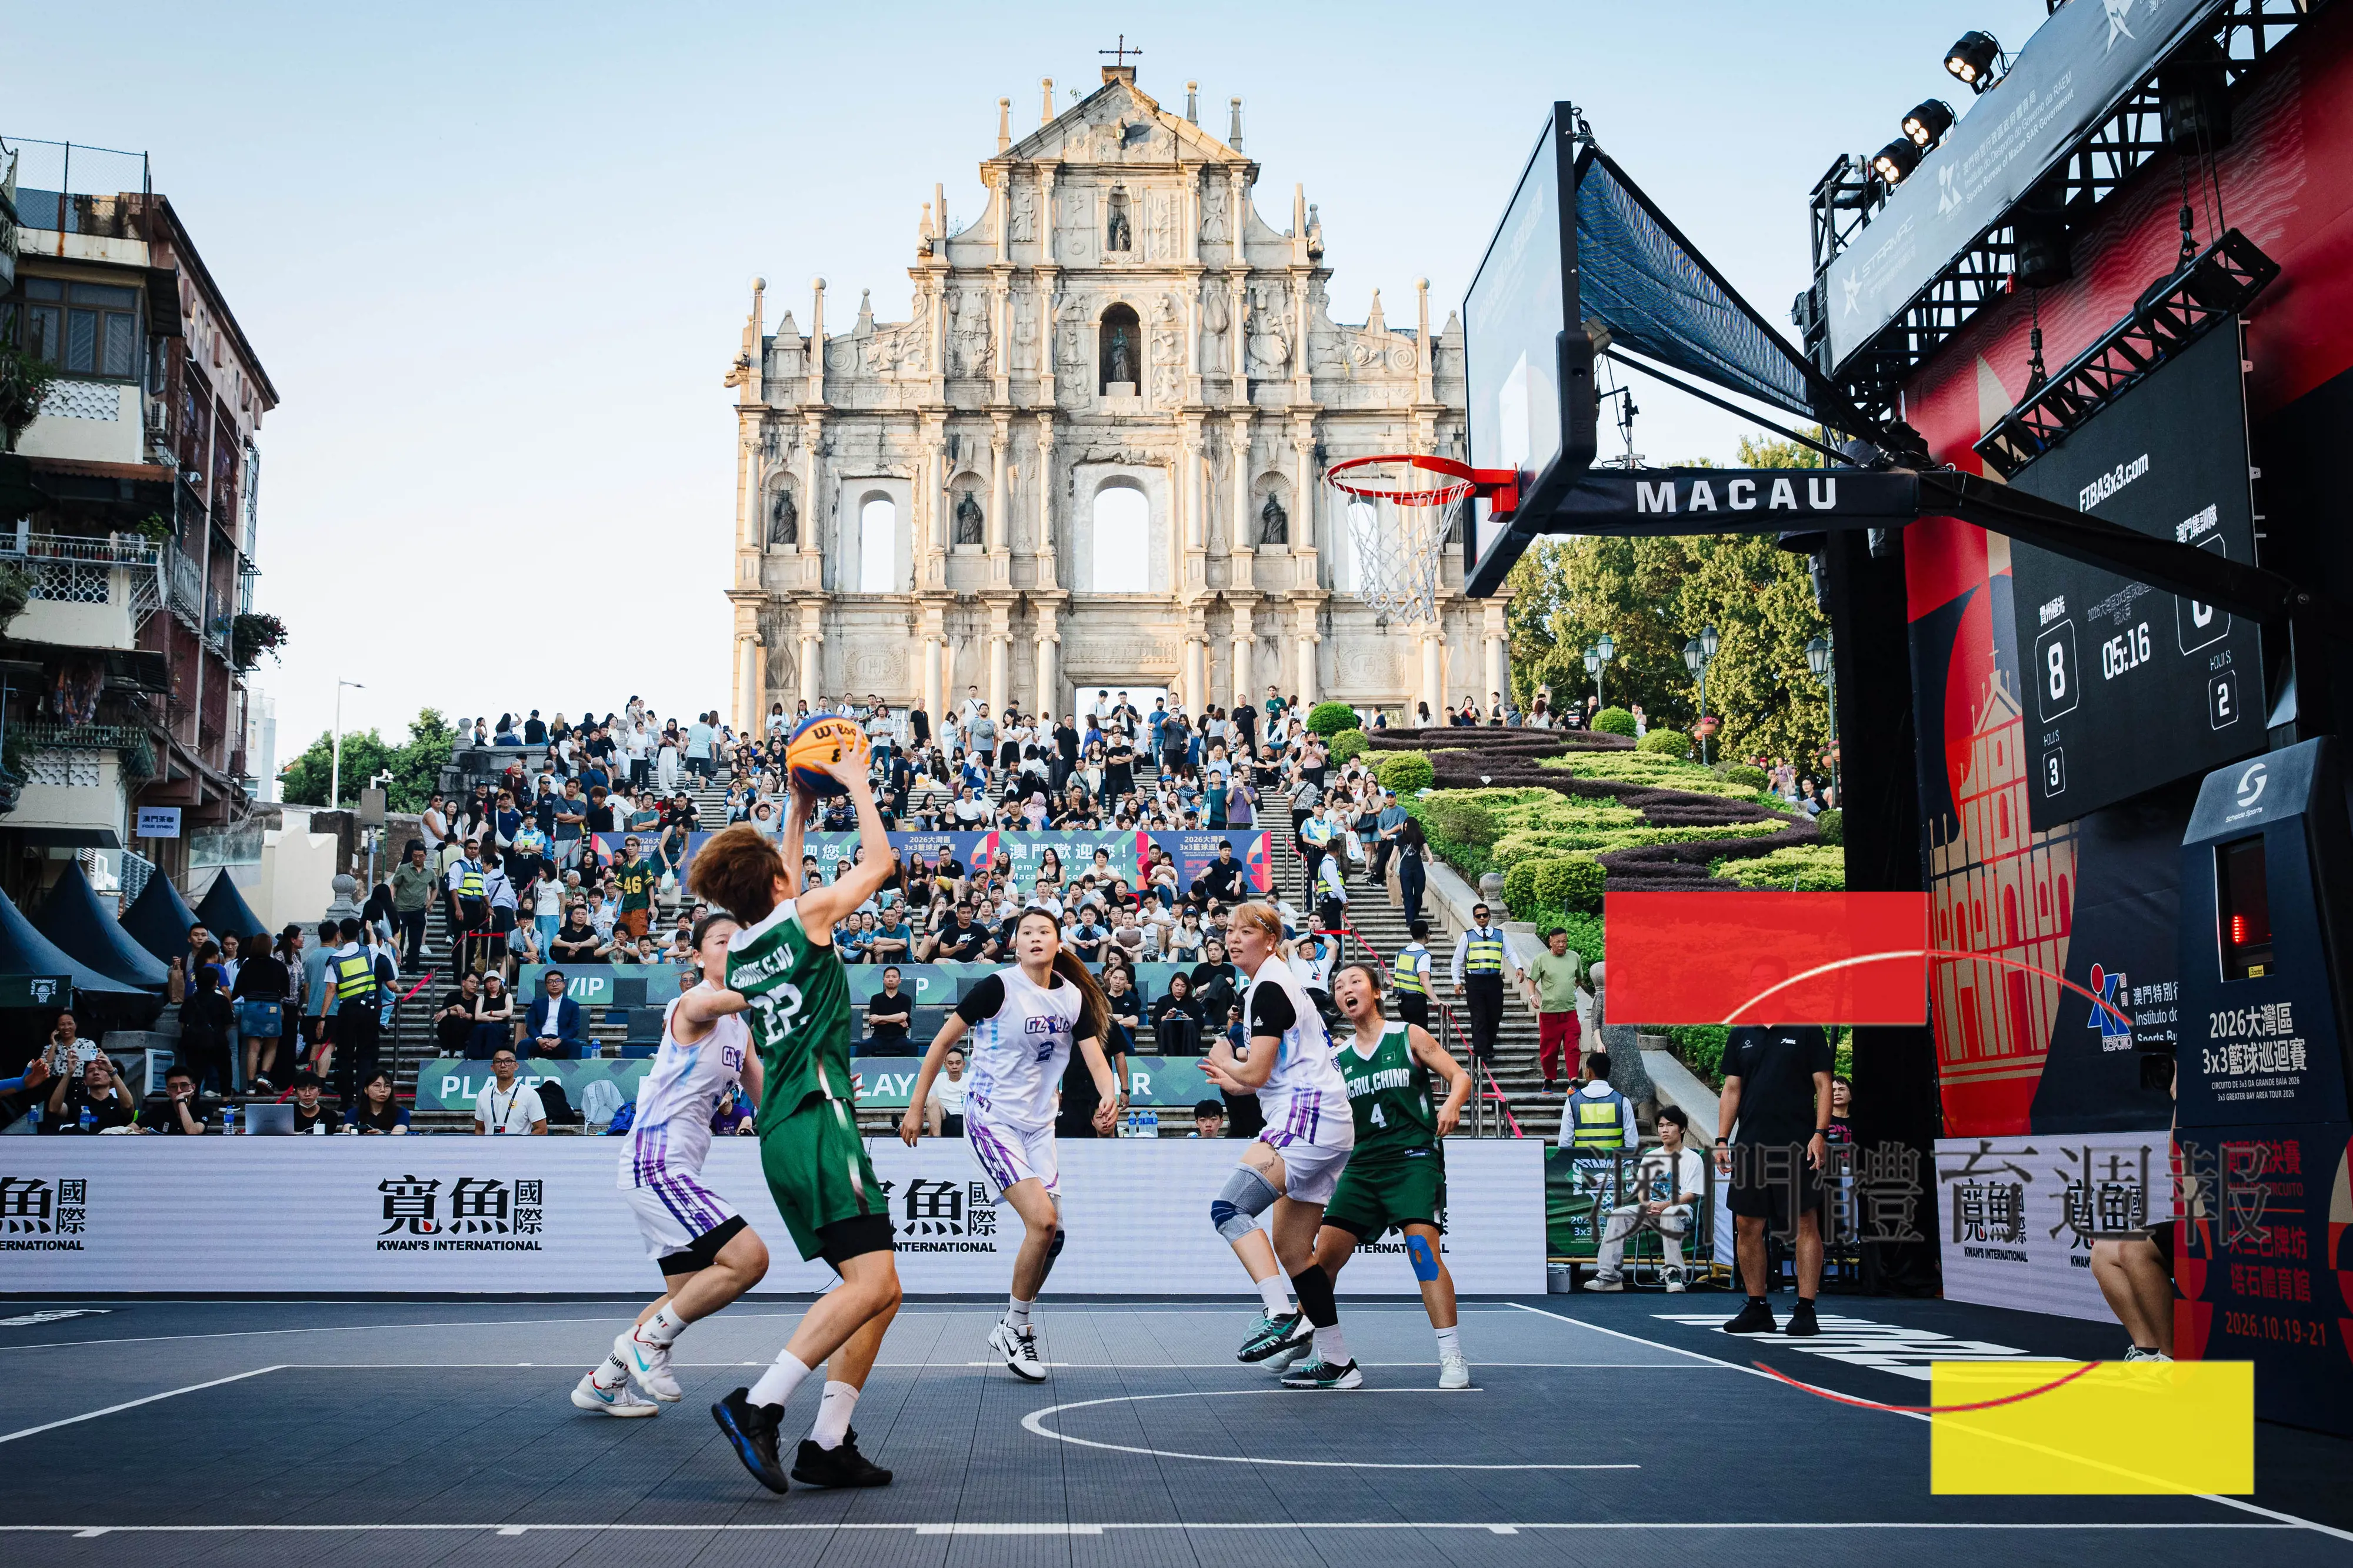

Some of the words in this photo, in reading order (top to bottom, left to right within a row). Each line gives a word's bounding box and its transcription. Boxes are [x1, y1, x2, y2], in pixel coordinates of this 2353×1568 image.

[2045, 94, 2053, 107] da
[2054, 70, 2072, 98] RAEM
[1967, 182, 1983, 203] Sports
[1983, 166, 2002, 185] Bureau
[2002, 155, 2008, 168] of
[2008, 141, 2025, 164] Macao
[2027, 126, 2039, 144] SAR
[2039, 89, 2074, 129] Government
[1637, 478, 1836, 513] MACAU
[2079, 453, 2148, 512] FIBA3x3.com
[2102, 622, 2150, 680] 05:16
[2048, 642, 2065, 700] 8
[2218, 683, 2229, 716] 2
[2049, 758, 2058, 786] 3
[2246, 806, 2263, 816] Sports
[624, 876, 642, 894] 46
[748, 983, 809, 1047] 22
[2135, 1009, 2167, 1026] Instituto
[2209, 1002, 2293, 1039] 2026大灣區
[1035, 1039, 1056, 1064] 2
[2202, 1037, 2307, 1075] 3x3籃球巡迴賽
[856, 1073, 918, 1097] LAY
[1346, 1068, 1410, 1100] CAU,CHINA
[2211, 1079, 2231, 1090] CIRCUITO
[2232, 1080, 2238, 1089] DE
[2239, 1080, 2247, 1088] 3x3
[2248, 1079, 2255, 1087] DA
[2255, 1078, 2275, 1086] GRANDE
[2288, 1076, 2299, 1085] 2026
[2226, 1092, 2245, 1101] GREATER
[2246, 1091, 2255, 1100] BAY
[2256, 1090, 2268, 1099] AREA
[2269, 1090, 2282, 1099] TOUR
[2283, 1089, 2294, 1097] 2026
[1370, 1103, 1387, 1128] 4
[1574, 1159, 1634, 1169] STARMC
[56, 1179, 87, 1235] 國際
[513, 1179, 543, 1235] 國際
[377, 1240, 429, 1251] KWAN'S
[434, 1240, 542, 1251] INTERNATIONAL
[894, 1242, 996, 1252] NTERNATIONAL
[1964, 1246, 1984, 1259] KWAN'S
[1985, 1248, 2028, 1263] INTERNATIONAL
[2070, 1255, 2091, 1269] KWAN'
[2225, 1311, 2326, 1346] 2026.10.19-21
